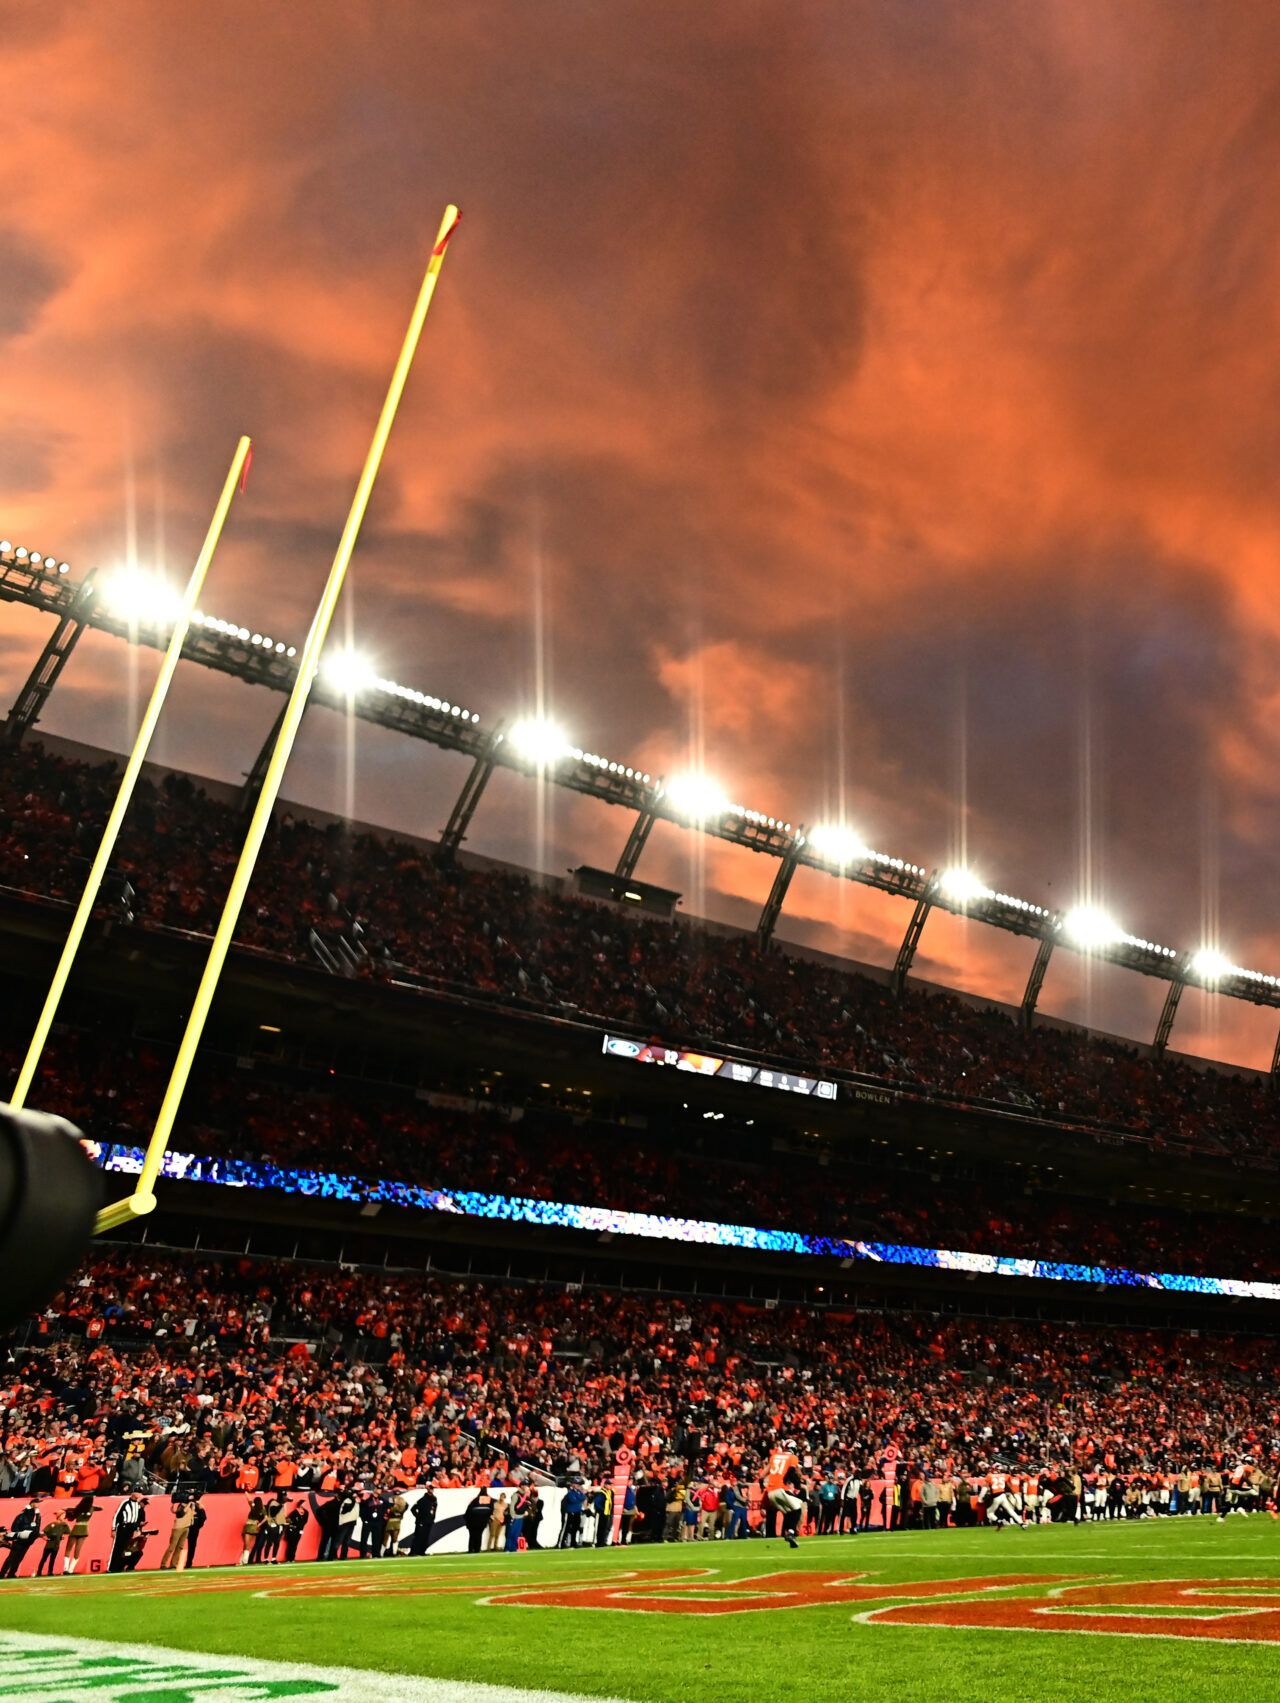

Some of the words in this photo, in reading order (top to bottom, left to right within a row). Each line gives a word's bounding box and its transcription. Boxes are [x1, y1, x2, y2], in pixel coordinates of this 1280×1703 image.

[855, 1090, 891, 1105] BOWLEN
[769, 1459, 787, 1475] 31
[90, 1559, 101, 1572] G
